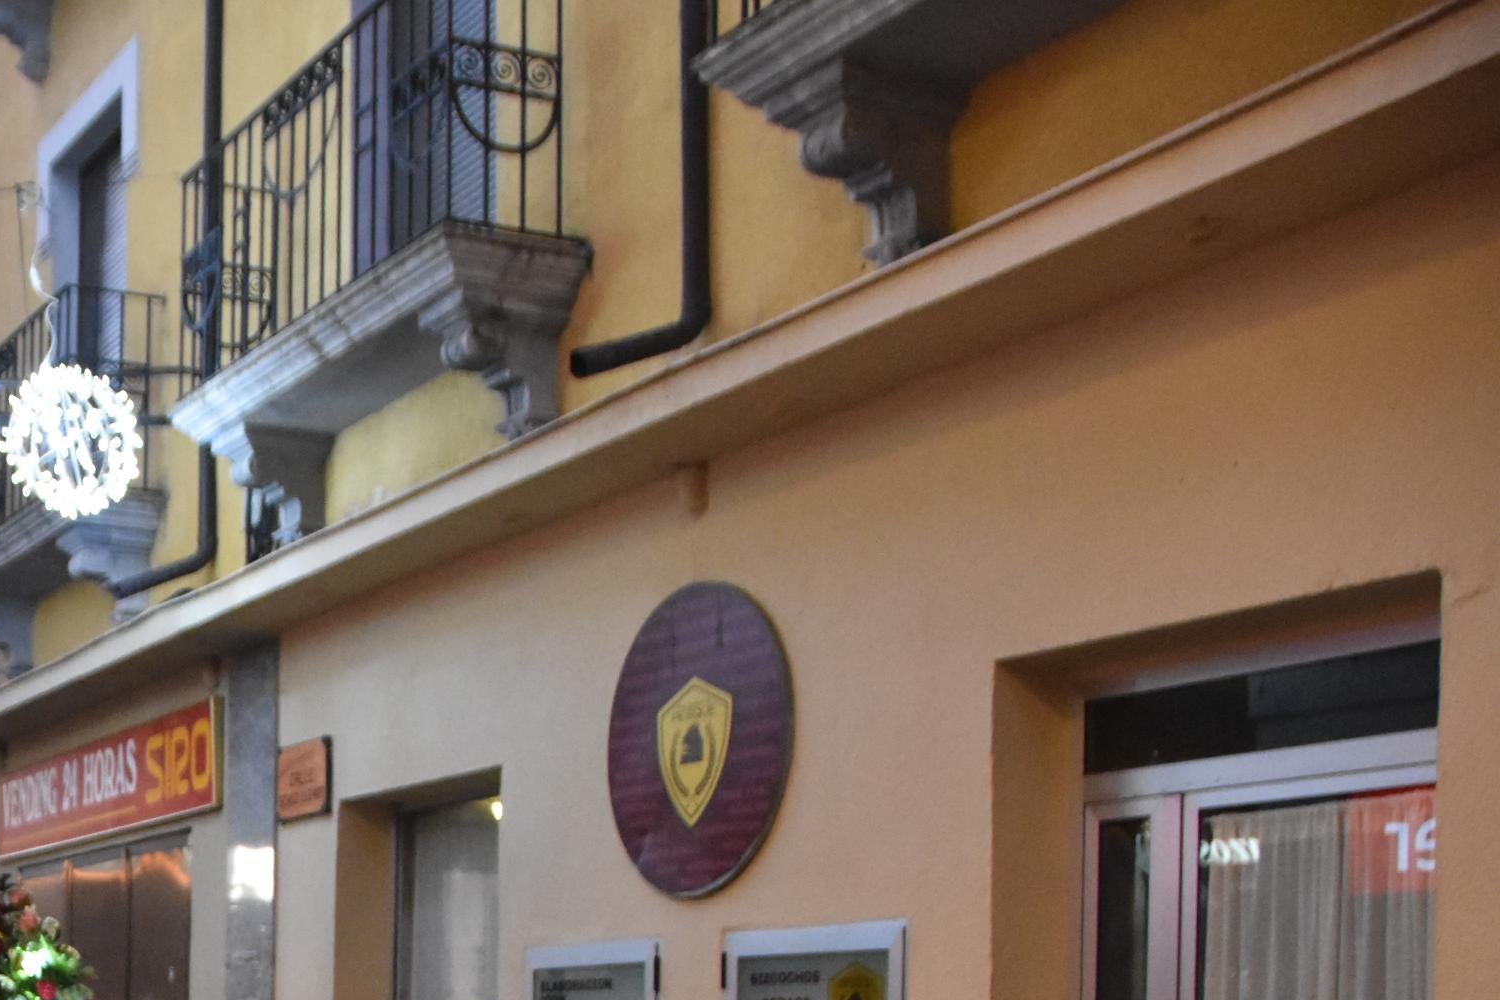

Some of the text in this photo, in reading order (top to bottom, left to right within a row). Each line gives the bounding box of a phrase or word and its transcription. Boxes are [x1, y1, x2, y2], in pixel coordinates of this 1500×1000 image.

[2, 717, 211, 829] VENDING 24 HORAS SIRO
[750, 970, 820, 986] BIZCOCHOS
